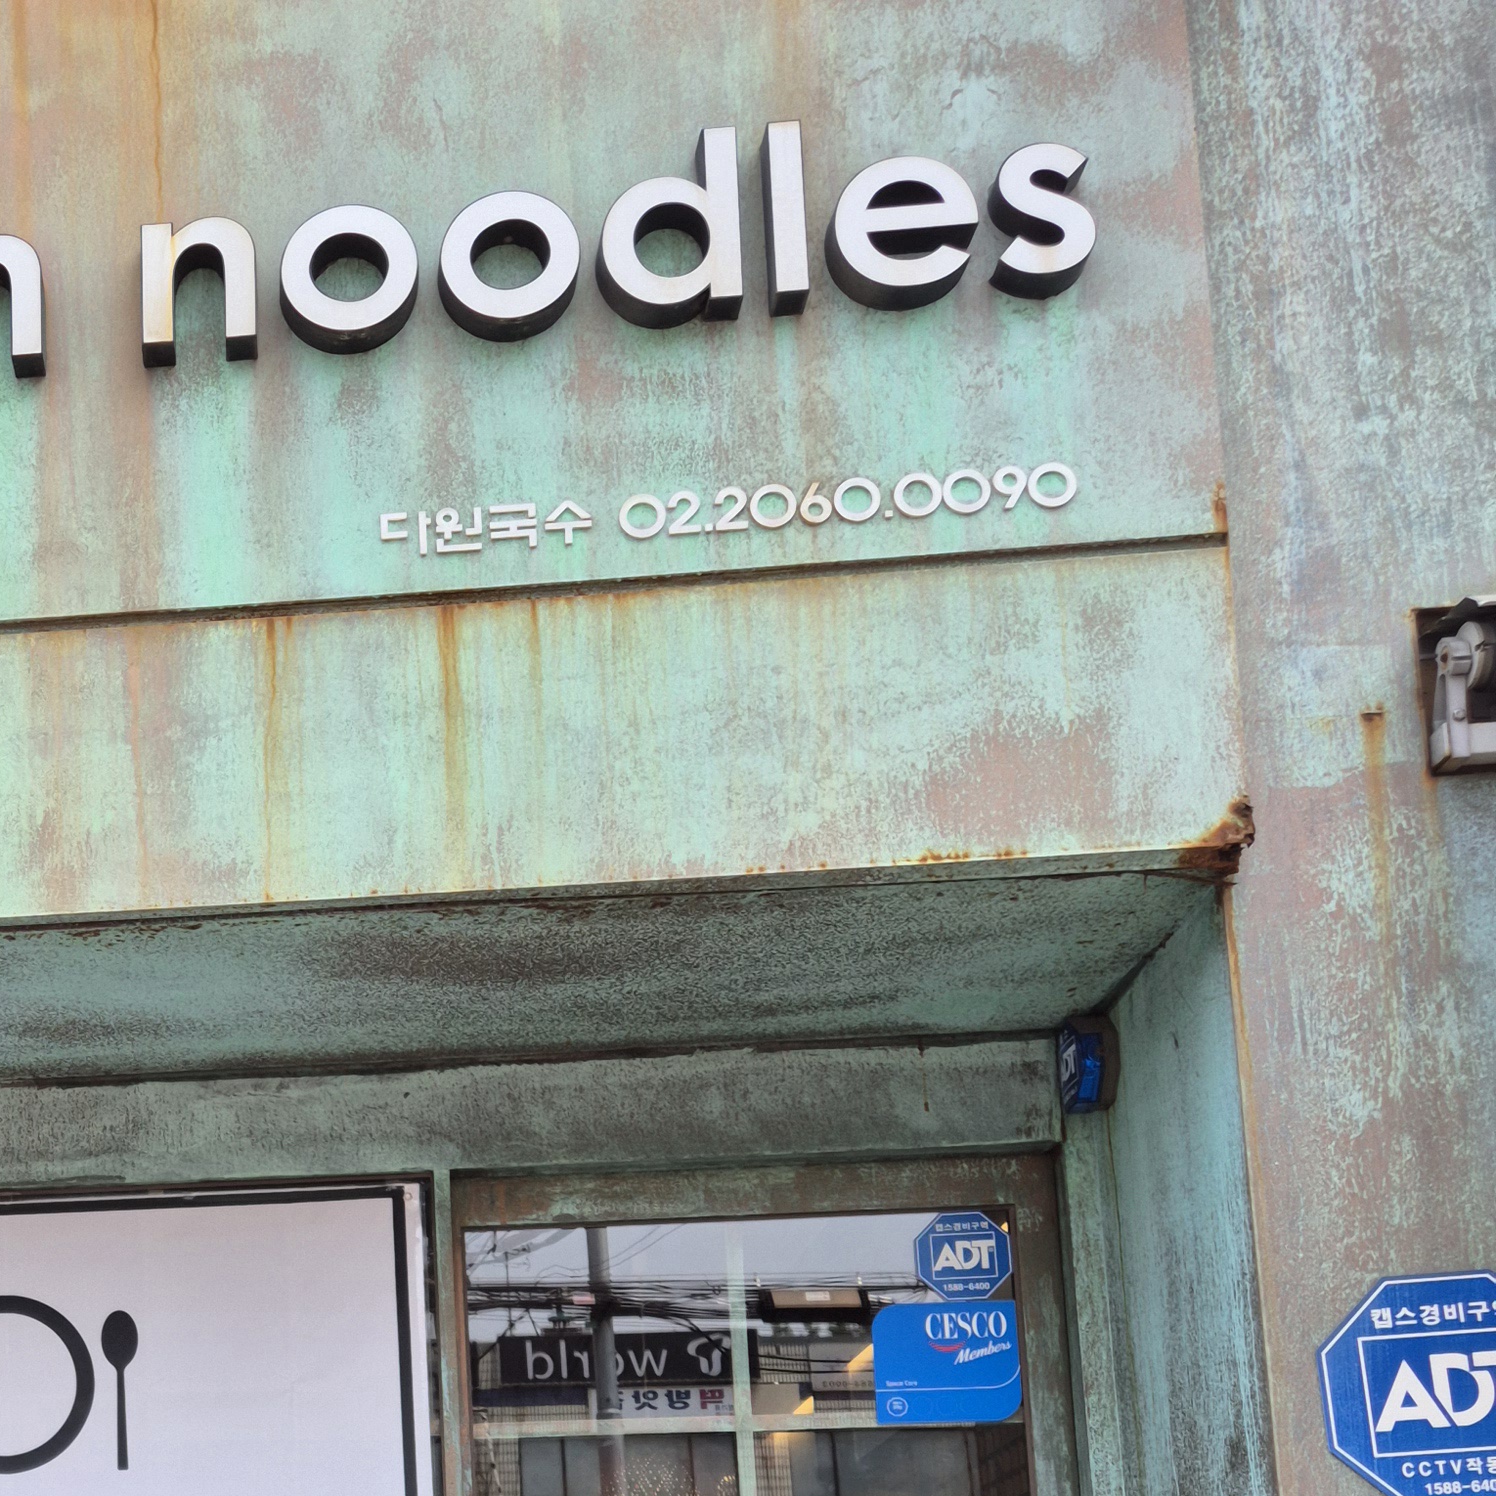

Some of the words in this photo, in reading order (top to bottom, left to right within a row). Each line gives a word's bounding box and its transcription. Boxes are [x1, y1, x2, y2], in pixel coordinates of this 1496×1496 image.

[138, 119, 1096, 368] noodles
[379, 500, 593, 556] 다원국수
[619, 462, 1078, 540] 02.2060.0090
[934, 1240, 995, 1271] ADT
[925, 1311, 1007, 1339] CESCO
[1370, 1301, 1496, 1329] 캡스경비구
[954, 1339, 1012, 1365] Members
